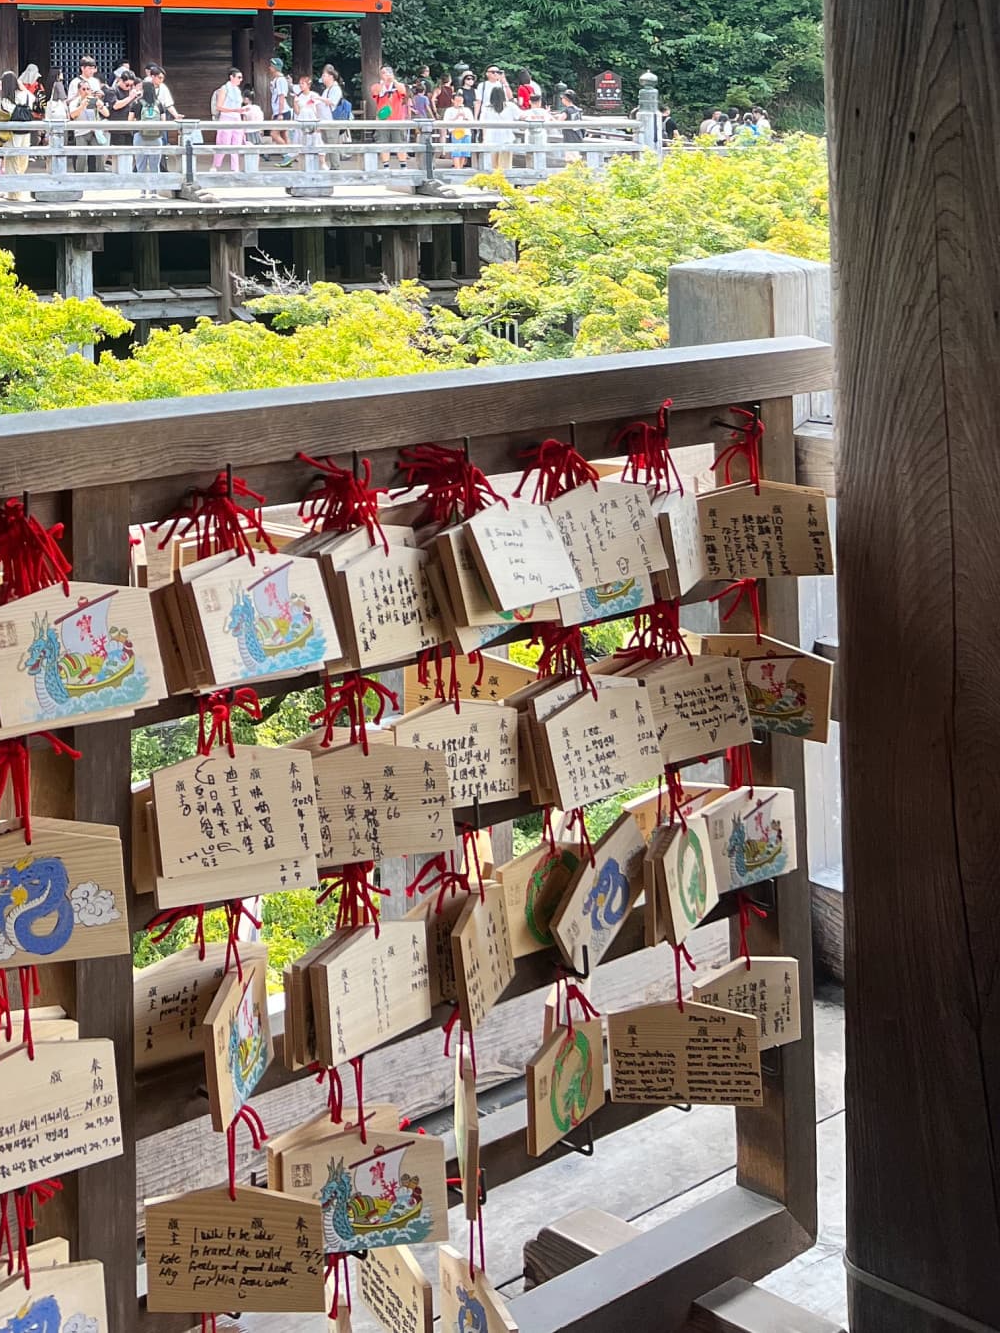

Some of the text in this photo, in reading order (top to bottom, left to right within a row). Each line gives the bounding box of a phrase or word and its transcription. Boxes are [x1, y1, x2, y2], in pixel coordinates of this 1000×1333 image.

[250, 768, 262, 780] 願
[289, 762, 302, 794] 奉納
[50, 1070, 63, 1084] 願
[90, 1058, 104, 1093] 奉納
[227, 1226, 236, 1240] to
[239, 1228, 250, 1241] be
[190, 1244, 199, 1258] to
[202, 1244, 232, 1258] travel
[221, 1261, 239, 1273] and
